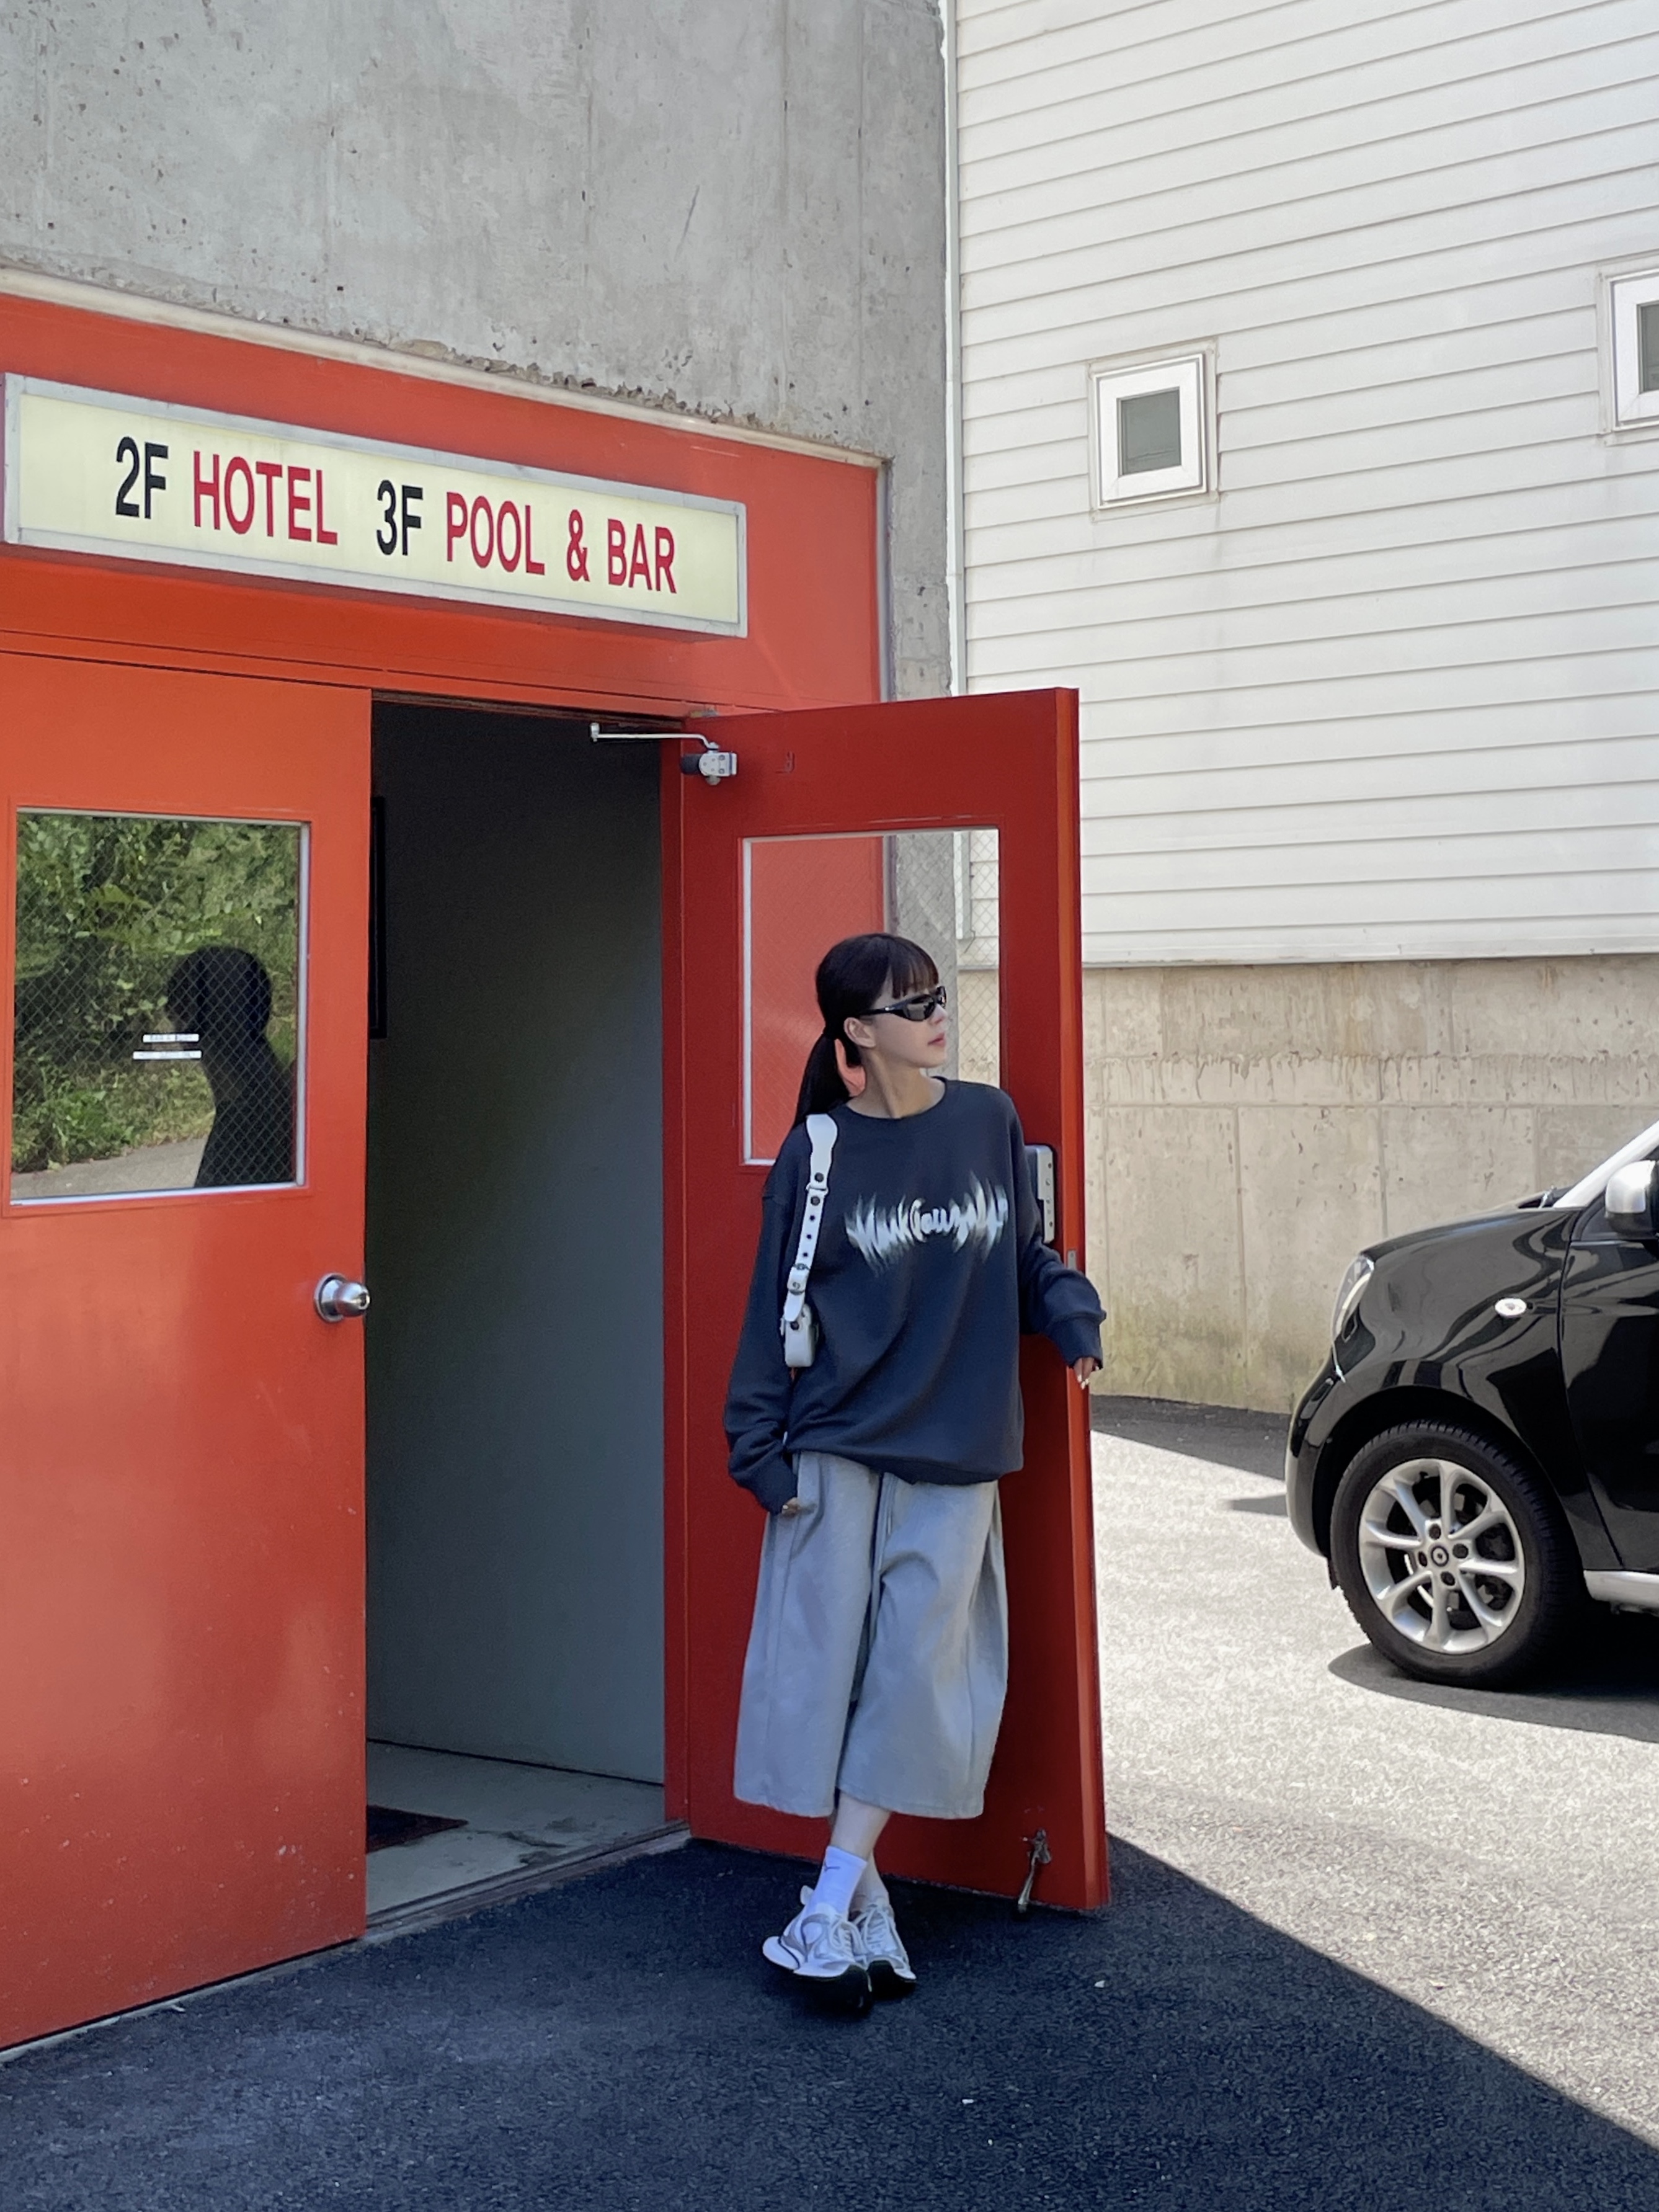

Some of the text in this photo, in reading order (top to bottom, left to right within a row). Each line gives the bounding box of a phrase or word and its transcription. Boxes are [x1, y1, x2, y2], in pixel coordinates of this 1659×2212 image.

[115, 436, 677, 594] 2F HOTEL 3F POOL & BAR
